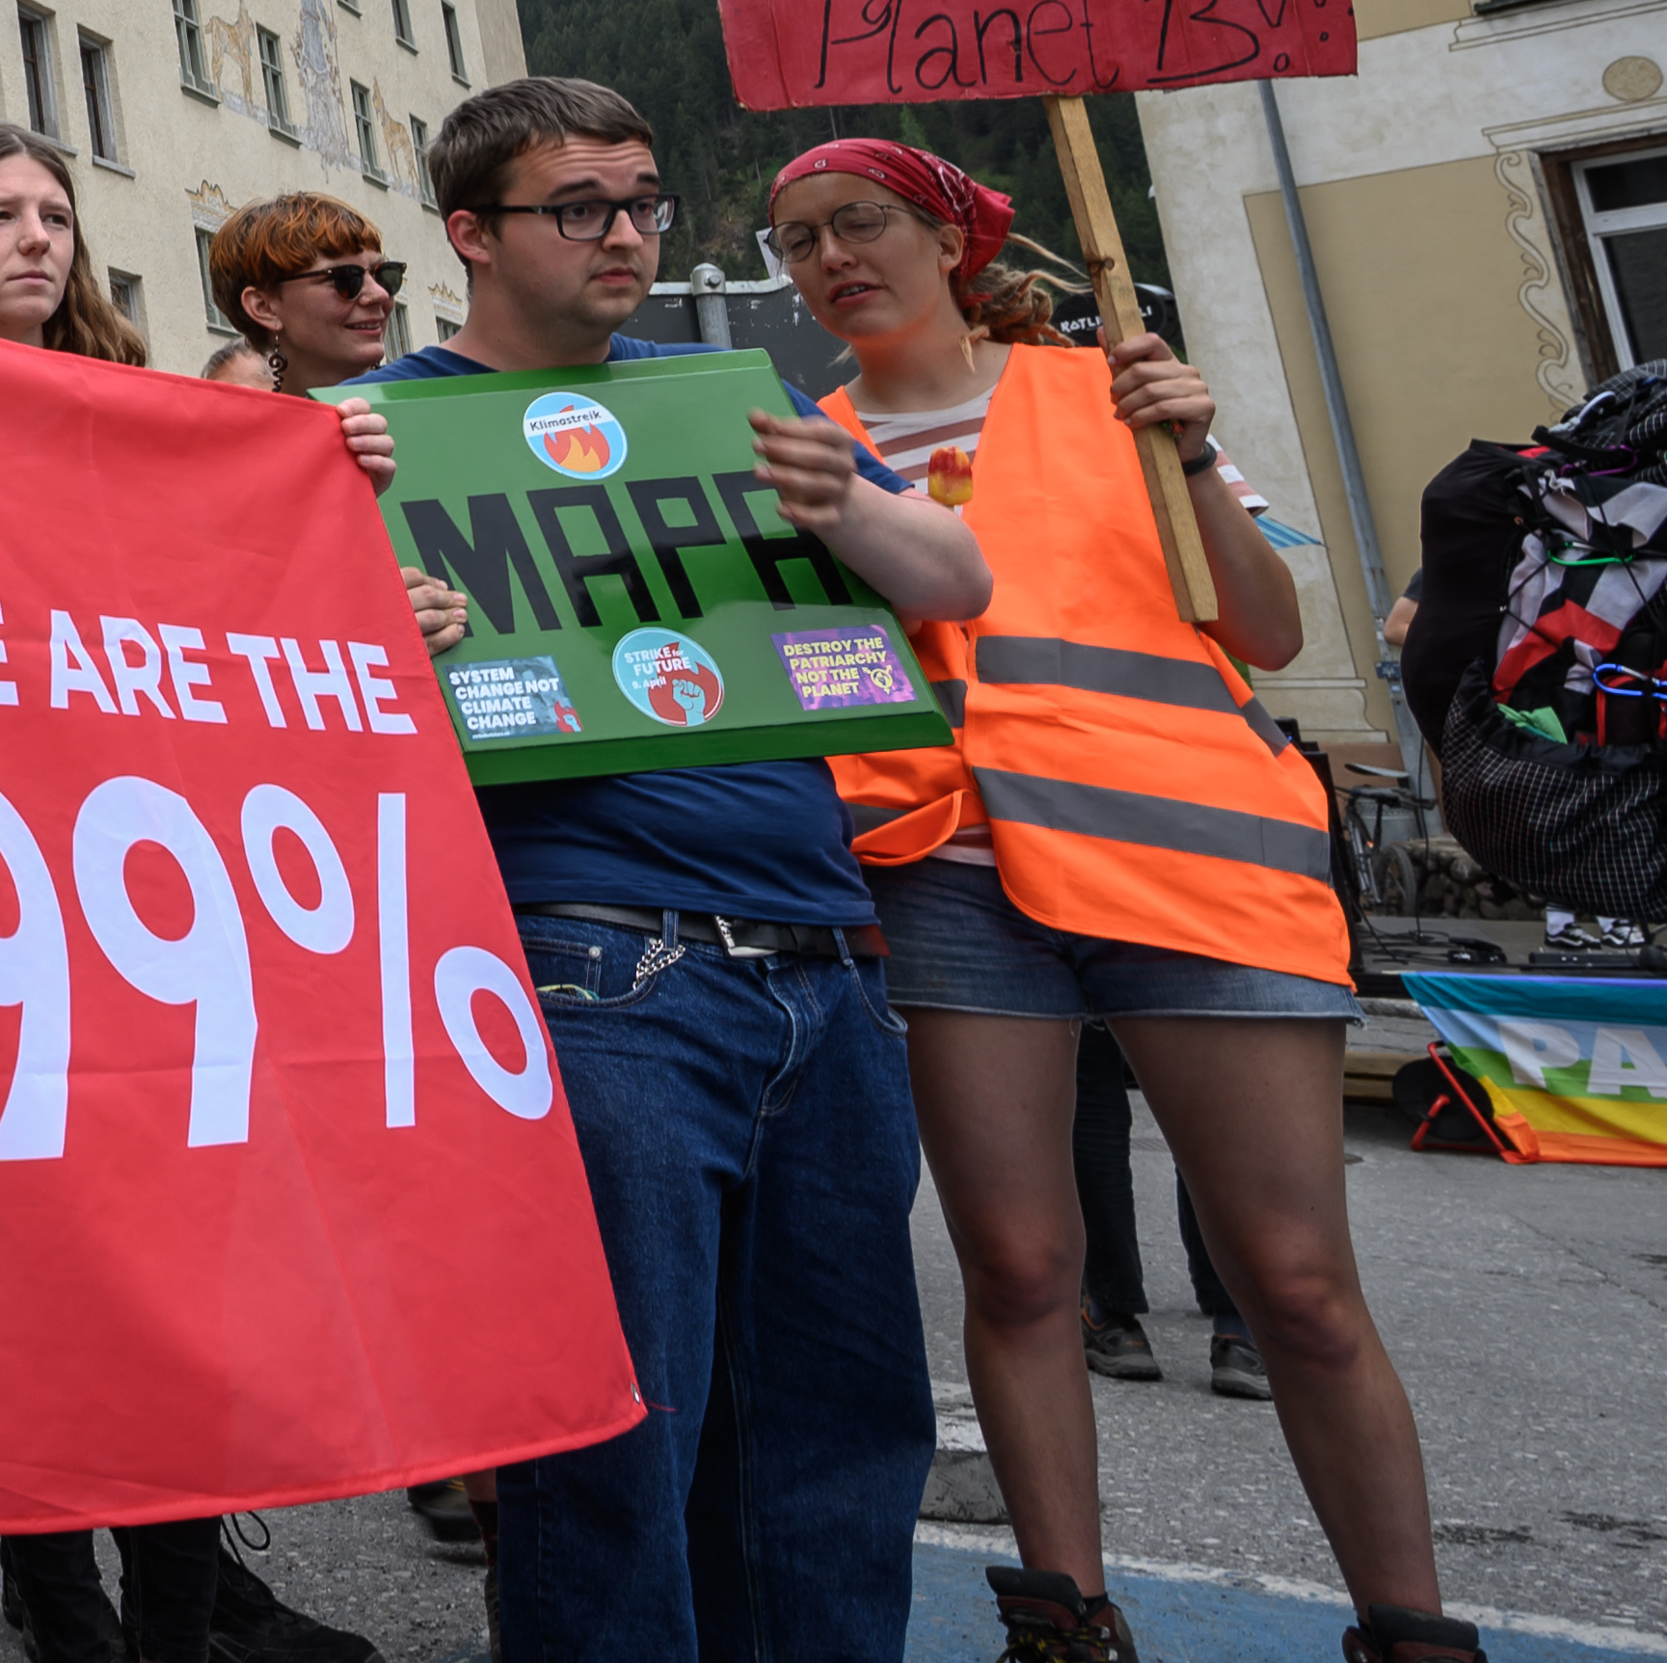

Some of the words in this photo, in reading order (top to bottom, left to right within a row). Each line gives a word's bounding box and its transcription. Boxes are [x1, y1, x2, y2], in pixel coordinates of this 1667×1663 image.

[530, 410, 602, 432] Klimastreik
[400, 469, 854, 638] MAPA
[624, 646, 672, 664] STRIKE
[672, 648, 684, 657] for
[783, 639, 852, 657] DESTROY
[853, 637, 884, 650] THE
[633, 657, 692, 676] FUTURE
[789, 651, 887, 670] PATRIARCHY
[50, 610, 228, 724] ARE
[225, 631, 418, 735] THE
[449, 667, 515, 685] SYSTEM
[796, 670, 828, 684] NOT
[829, 667, 860, 681] THE
[455, 681, 524, 699] CHANGE
[526, 677, 559, 693] NOT
[643, 676, 667, 690] April
[802, 682, 859, 698] PLANET
[461, 696, 532, 715] CLIMATE
[467, 711, 536, 730] CHANGE
